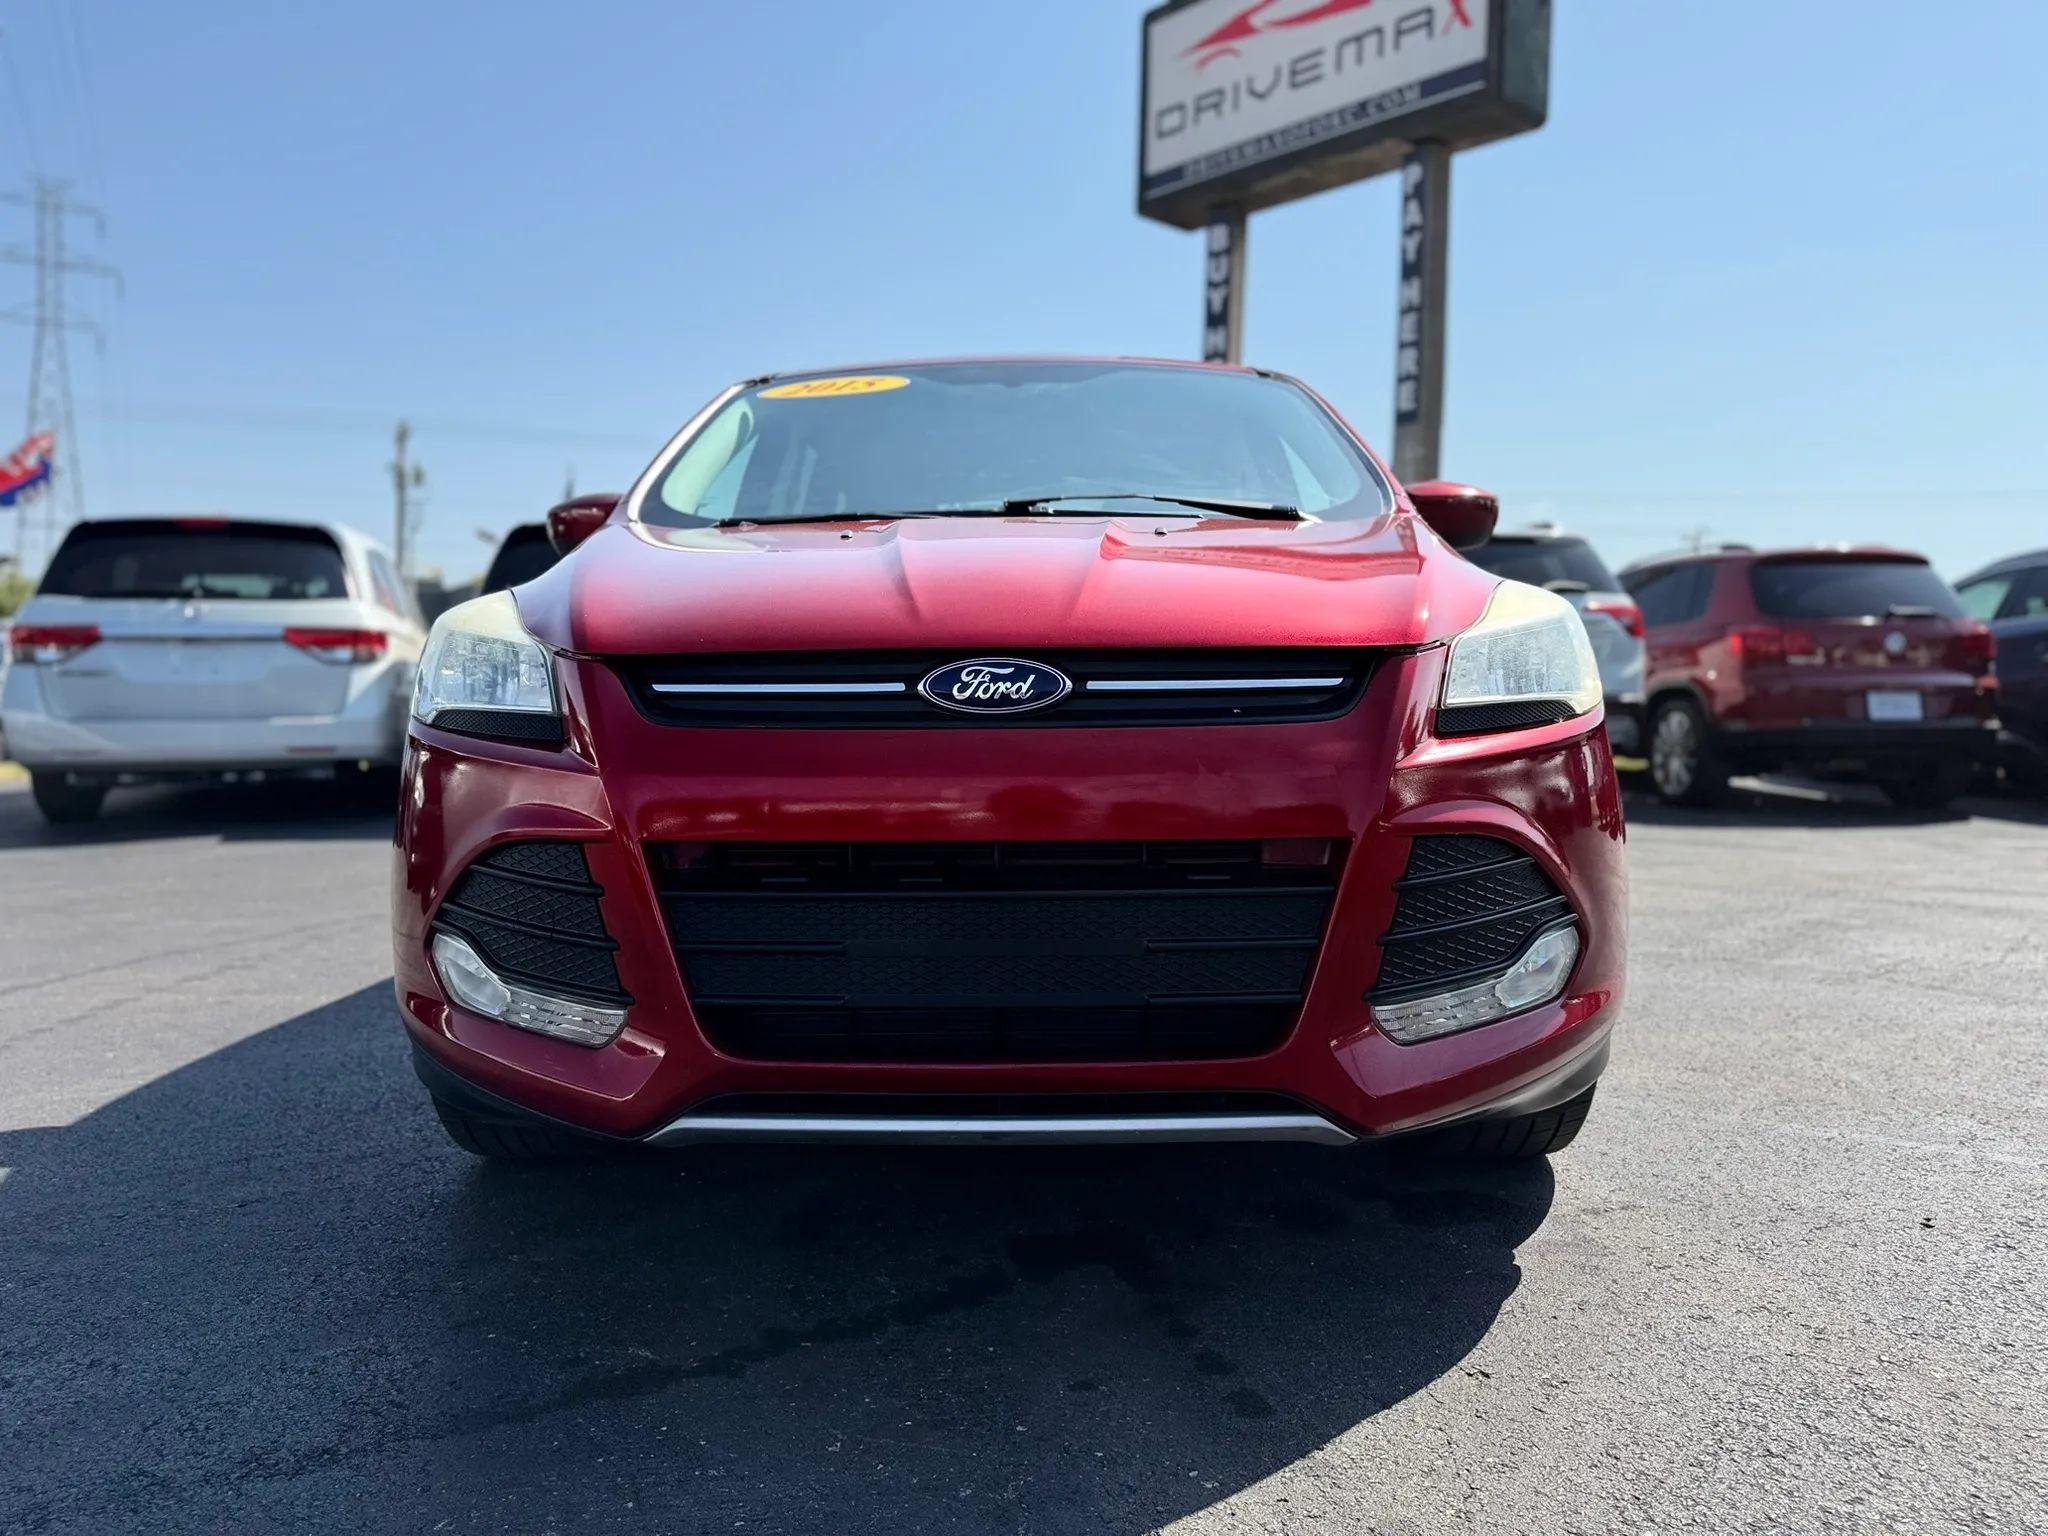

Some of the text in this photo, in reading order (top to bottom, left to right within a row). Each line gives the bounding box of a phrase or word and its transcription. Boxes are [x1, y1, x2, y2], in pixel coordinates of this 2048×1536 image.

[1206, 222, 1231, 316] BUY
[1399, 161, 1424, 413] PAY HERE
[952, 665, 1036, 700] Ford
